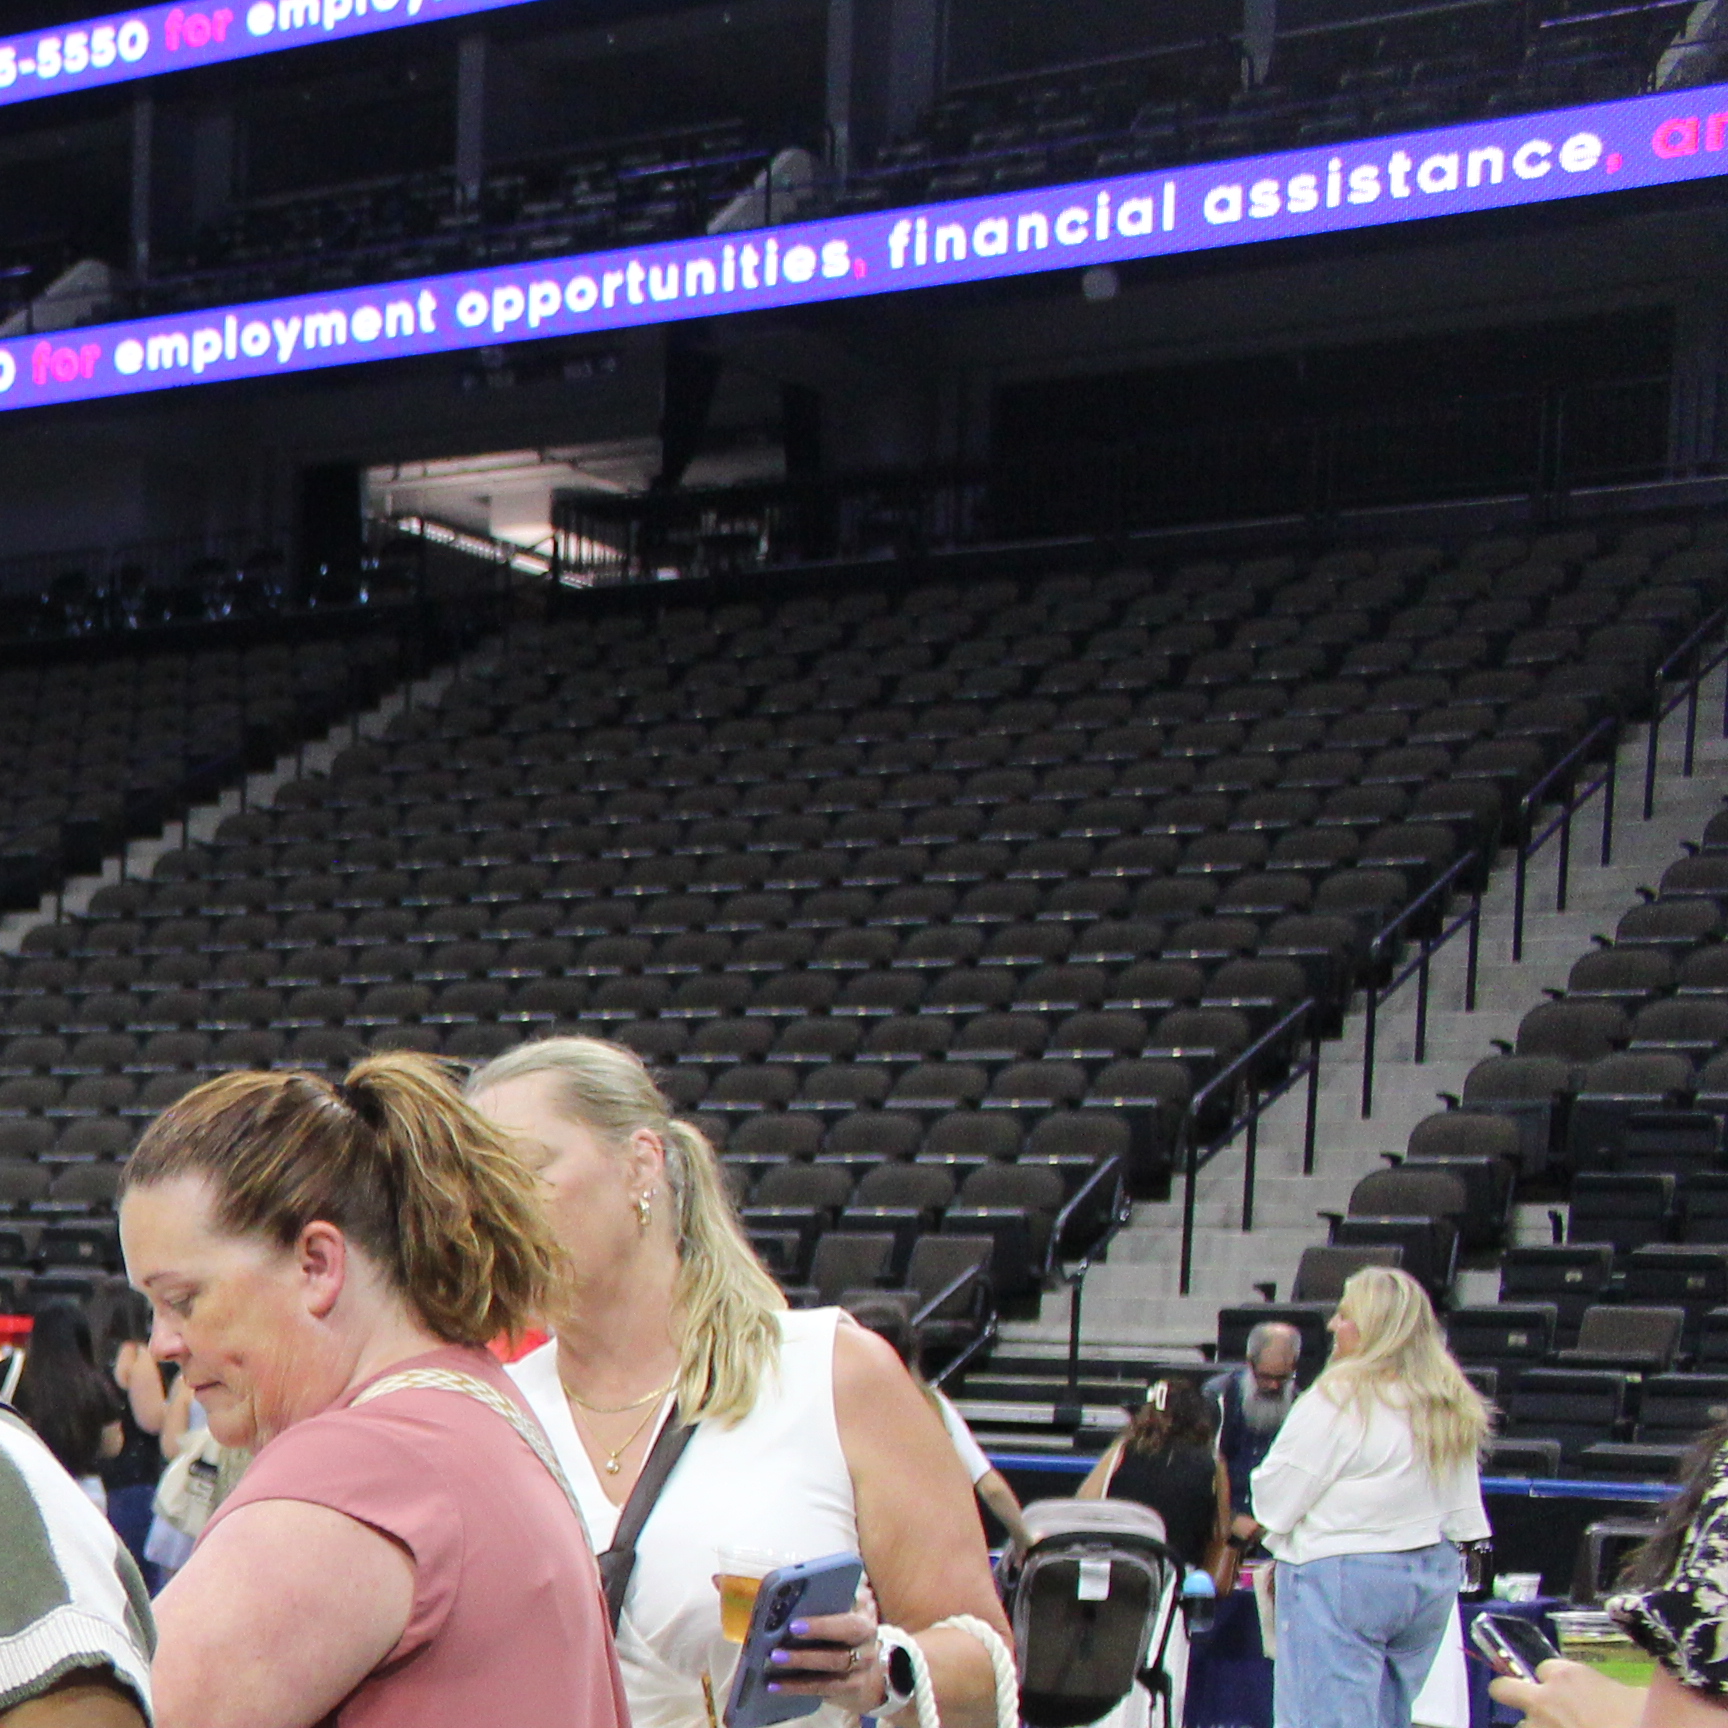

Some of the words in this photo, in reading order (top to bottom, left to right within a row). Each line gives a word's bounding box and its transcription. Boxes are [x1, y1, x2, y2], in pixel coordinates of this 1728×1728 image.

[164, 6, 234, 52] for
[30, 340, 102, 385] for
[113, 290, 437, 374] employment
[455, 237, 868, 331] opportunities,
[886, 181, 1176, 270] financial
[1202, 130, 1624, 225] assistance,
